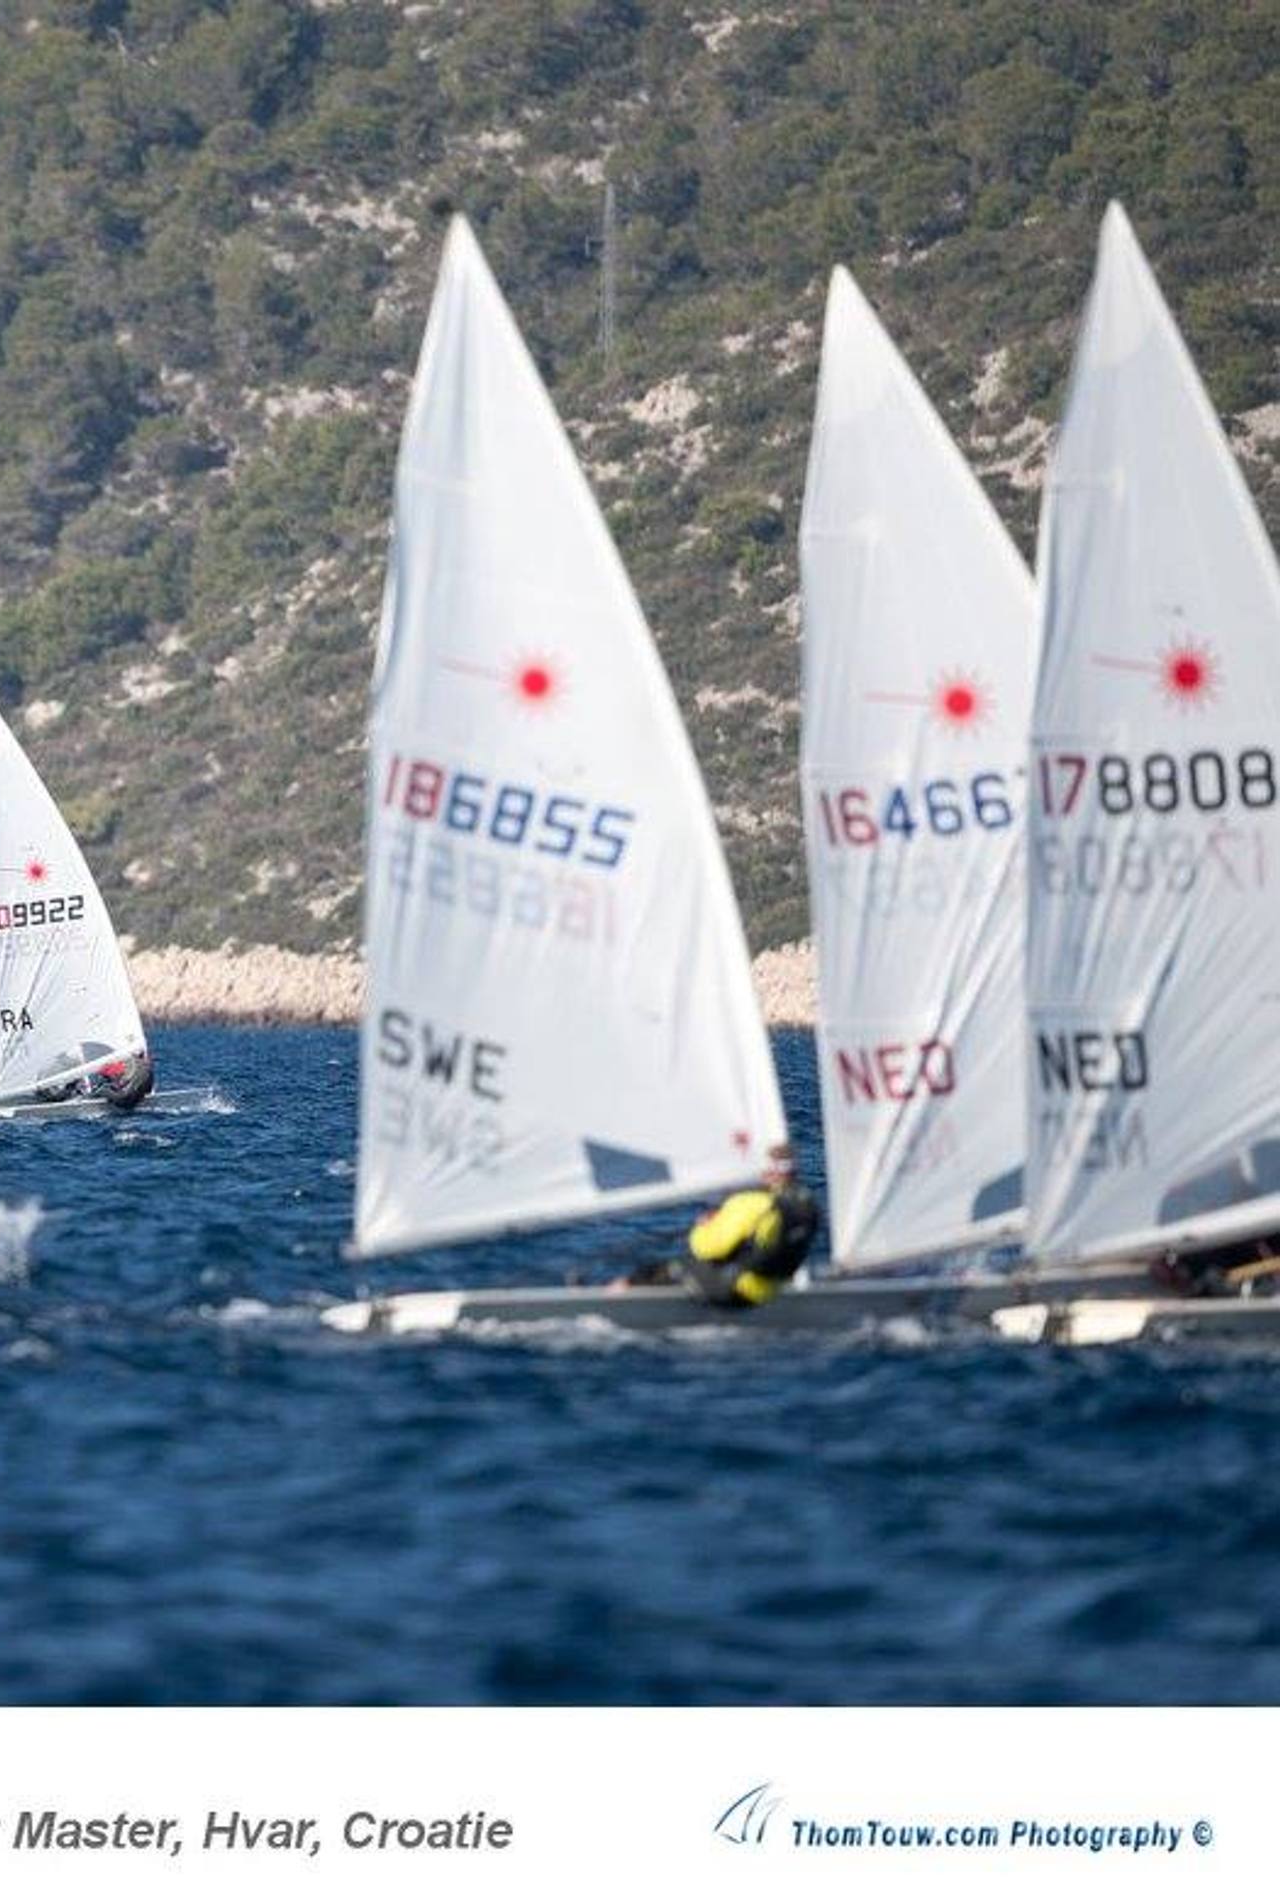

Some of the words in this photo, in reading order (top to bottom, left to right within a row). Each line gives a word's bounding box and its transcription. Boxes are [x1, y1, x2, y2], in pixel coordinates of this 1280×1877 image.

[383, 754, 635, 868] 186855
[819, 773, 1024, 846] 16466
[1040, 750, 1276, 816] 178808
[377, 1008, 508, 1102] SWE
